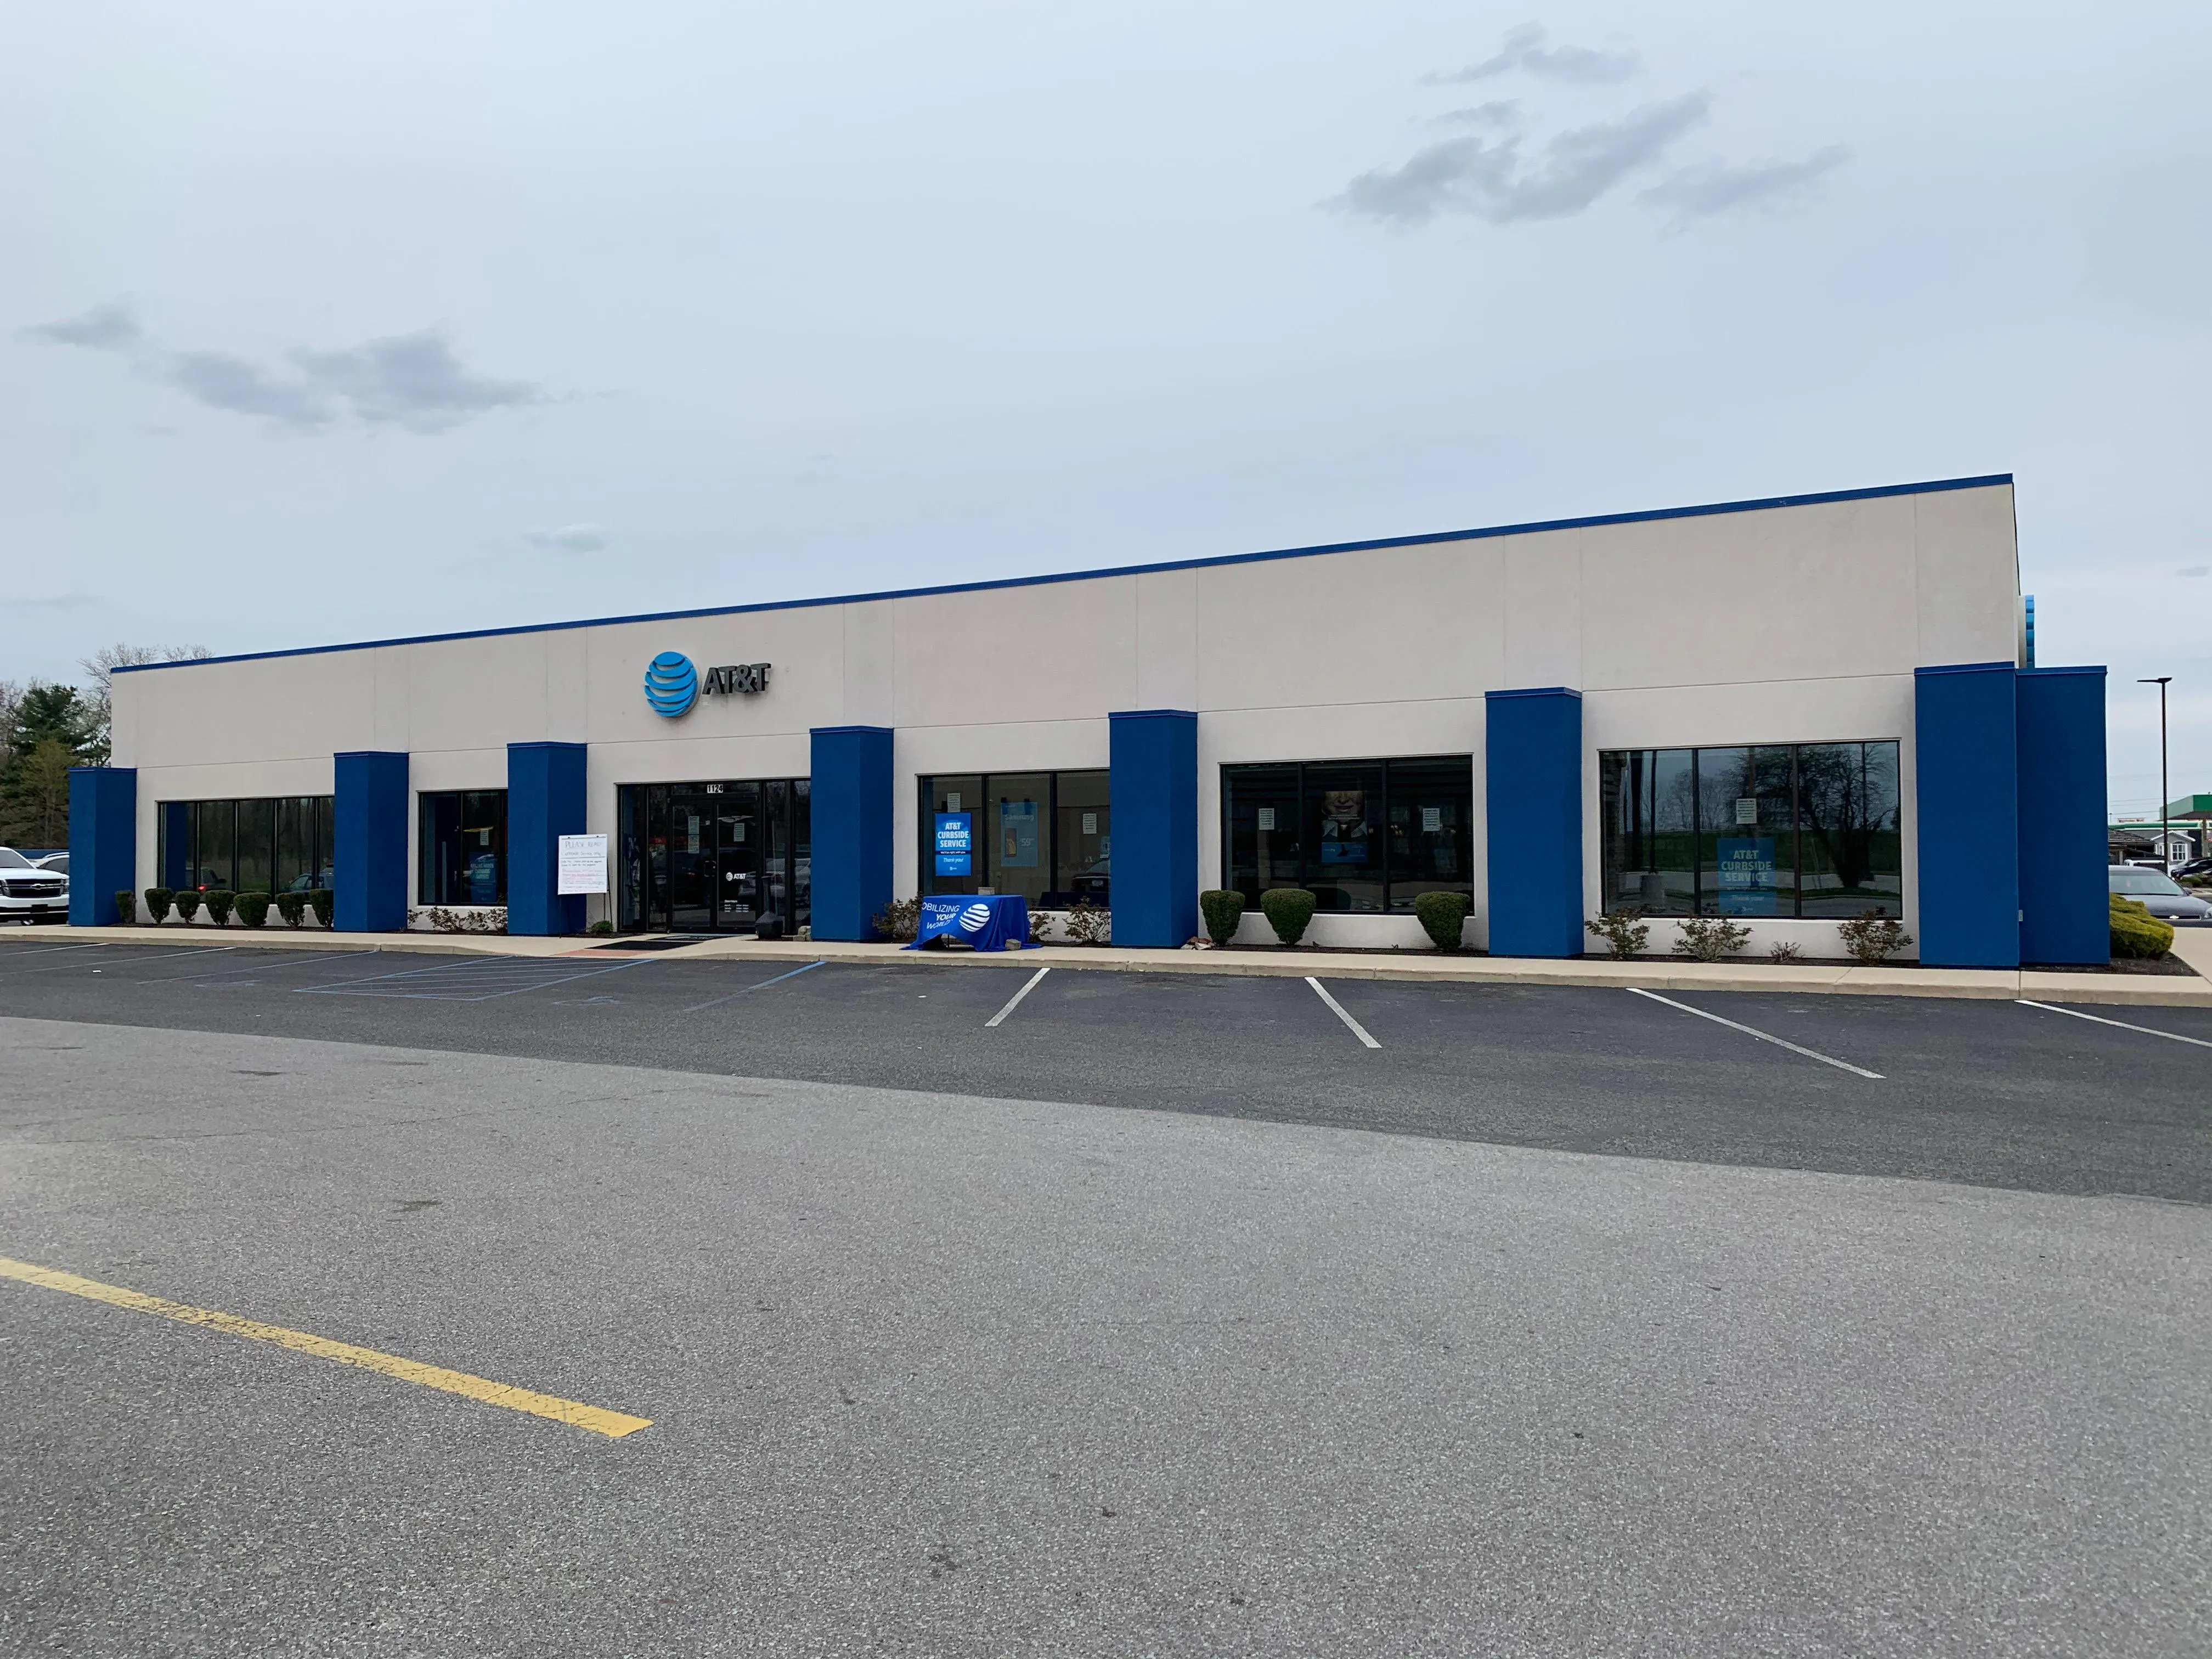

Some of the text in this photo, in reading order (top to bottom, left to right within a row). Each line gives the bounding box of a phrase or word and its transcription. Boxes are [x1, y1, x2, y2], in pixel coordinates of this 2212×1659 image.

[702, 663, 771, 695] AT&T
[708, 785, 723, 793] 1124
[945, 822, 961, 830] AT&T
[938, 831, 969, 839] CURBSIDE
[940, 839, 967, 848] SERVICE
[1733, 850, 1759, 859] AT&T
[1721, 861, 1772, 871] CURBSIDE
[1724, 872, 1768, 882] SERVICE
[922, 902, 961, 912] OBILIZING
[936, 913, 957, 921] YOUR
